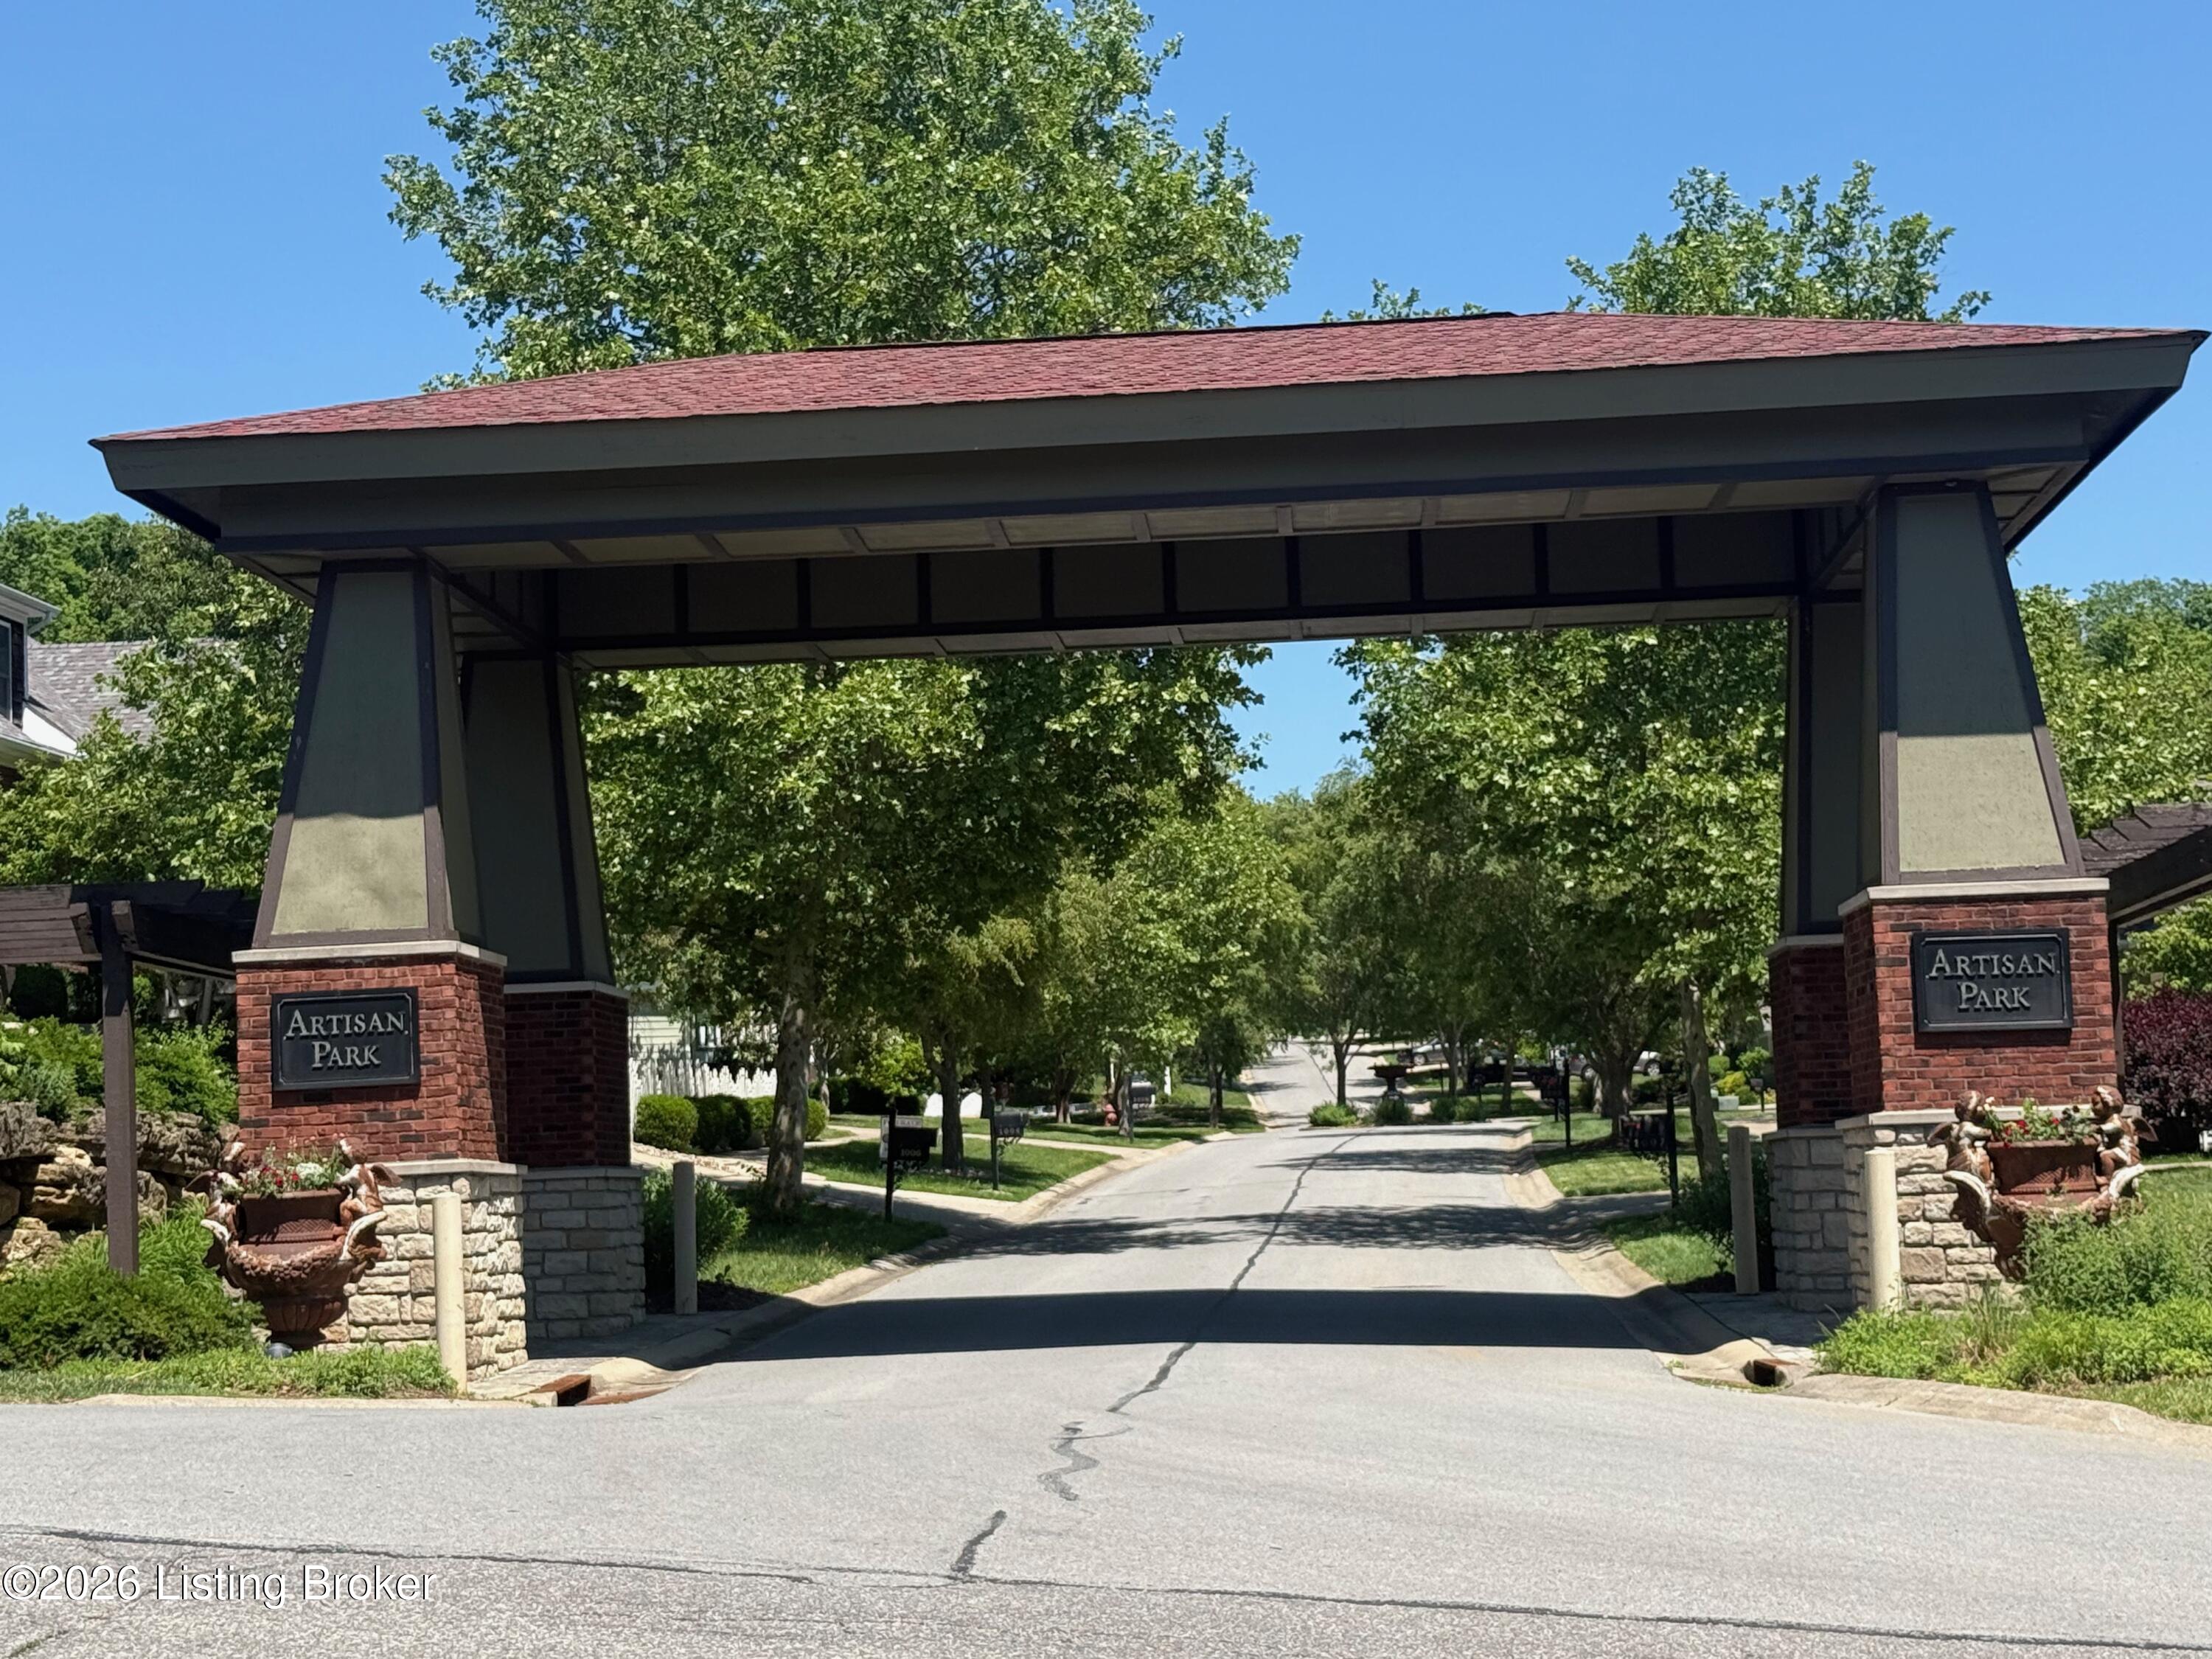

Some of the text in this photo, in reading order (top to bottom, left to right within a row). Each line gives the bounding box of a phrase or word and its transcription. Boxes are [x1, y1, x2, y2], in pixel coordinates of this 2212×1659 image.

[1928, 948, 2056, 976] ARTISAN
[1958, 981, 2031, 1009] PARK
[285, 1009, 406, 1037] ARTISAN
[312, 1040, 382, 1068] PARK
